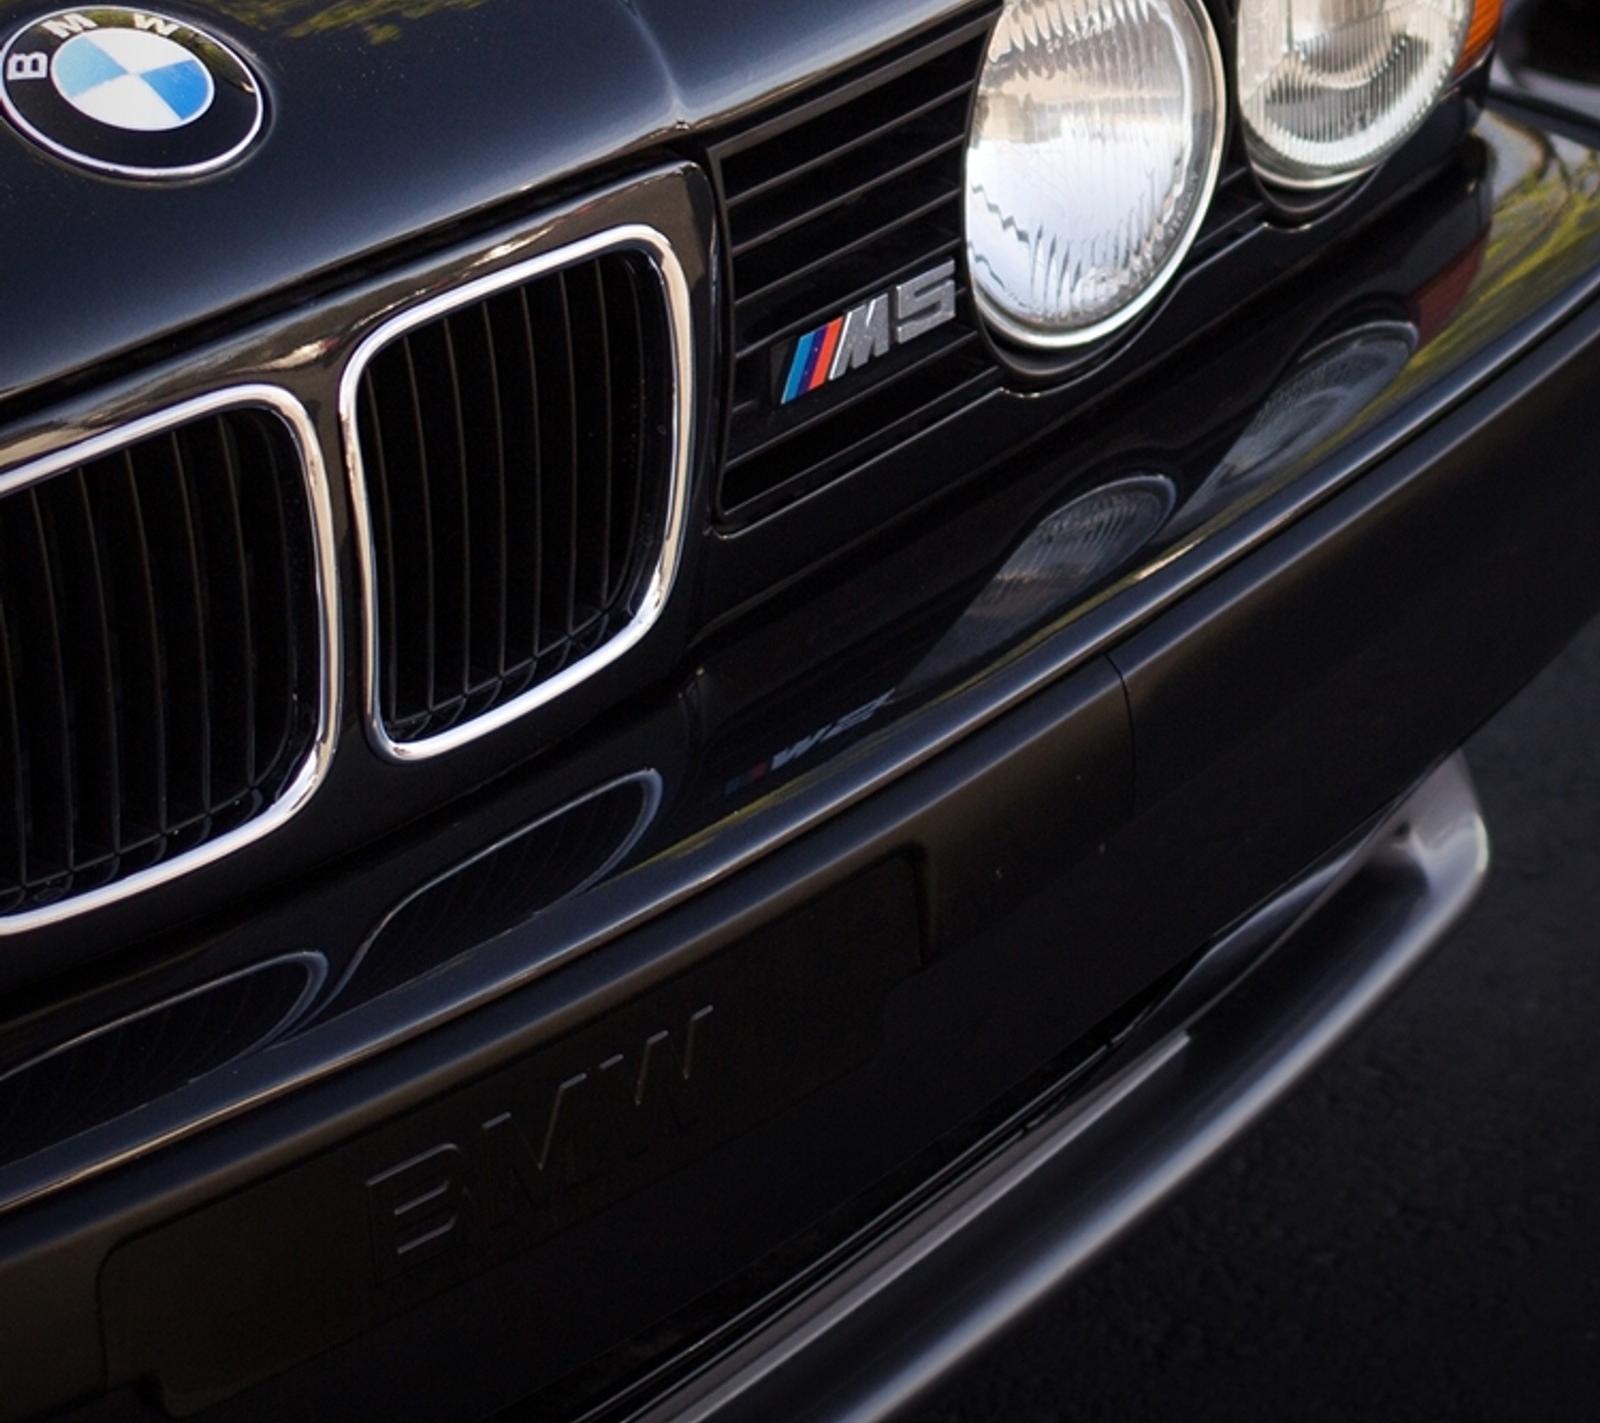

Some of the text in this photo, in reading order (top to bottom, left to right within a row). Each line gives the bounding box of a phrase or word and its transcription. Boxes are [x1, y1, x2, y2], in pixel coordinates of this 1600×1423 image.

[7, 13, 181, 80] BMW
[828, 258, 956, 381] M5
[366, 1005, 714, 1288] BMW
